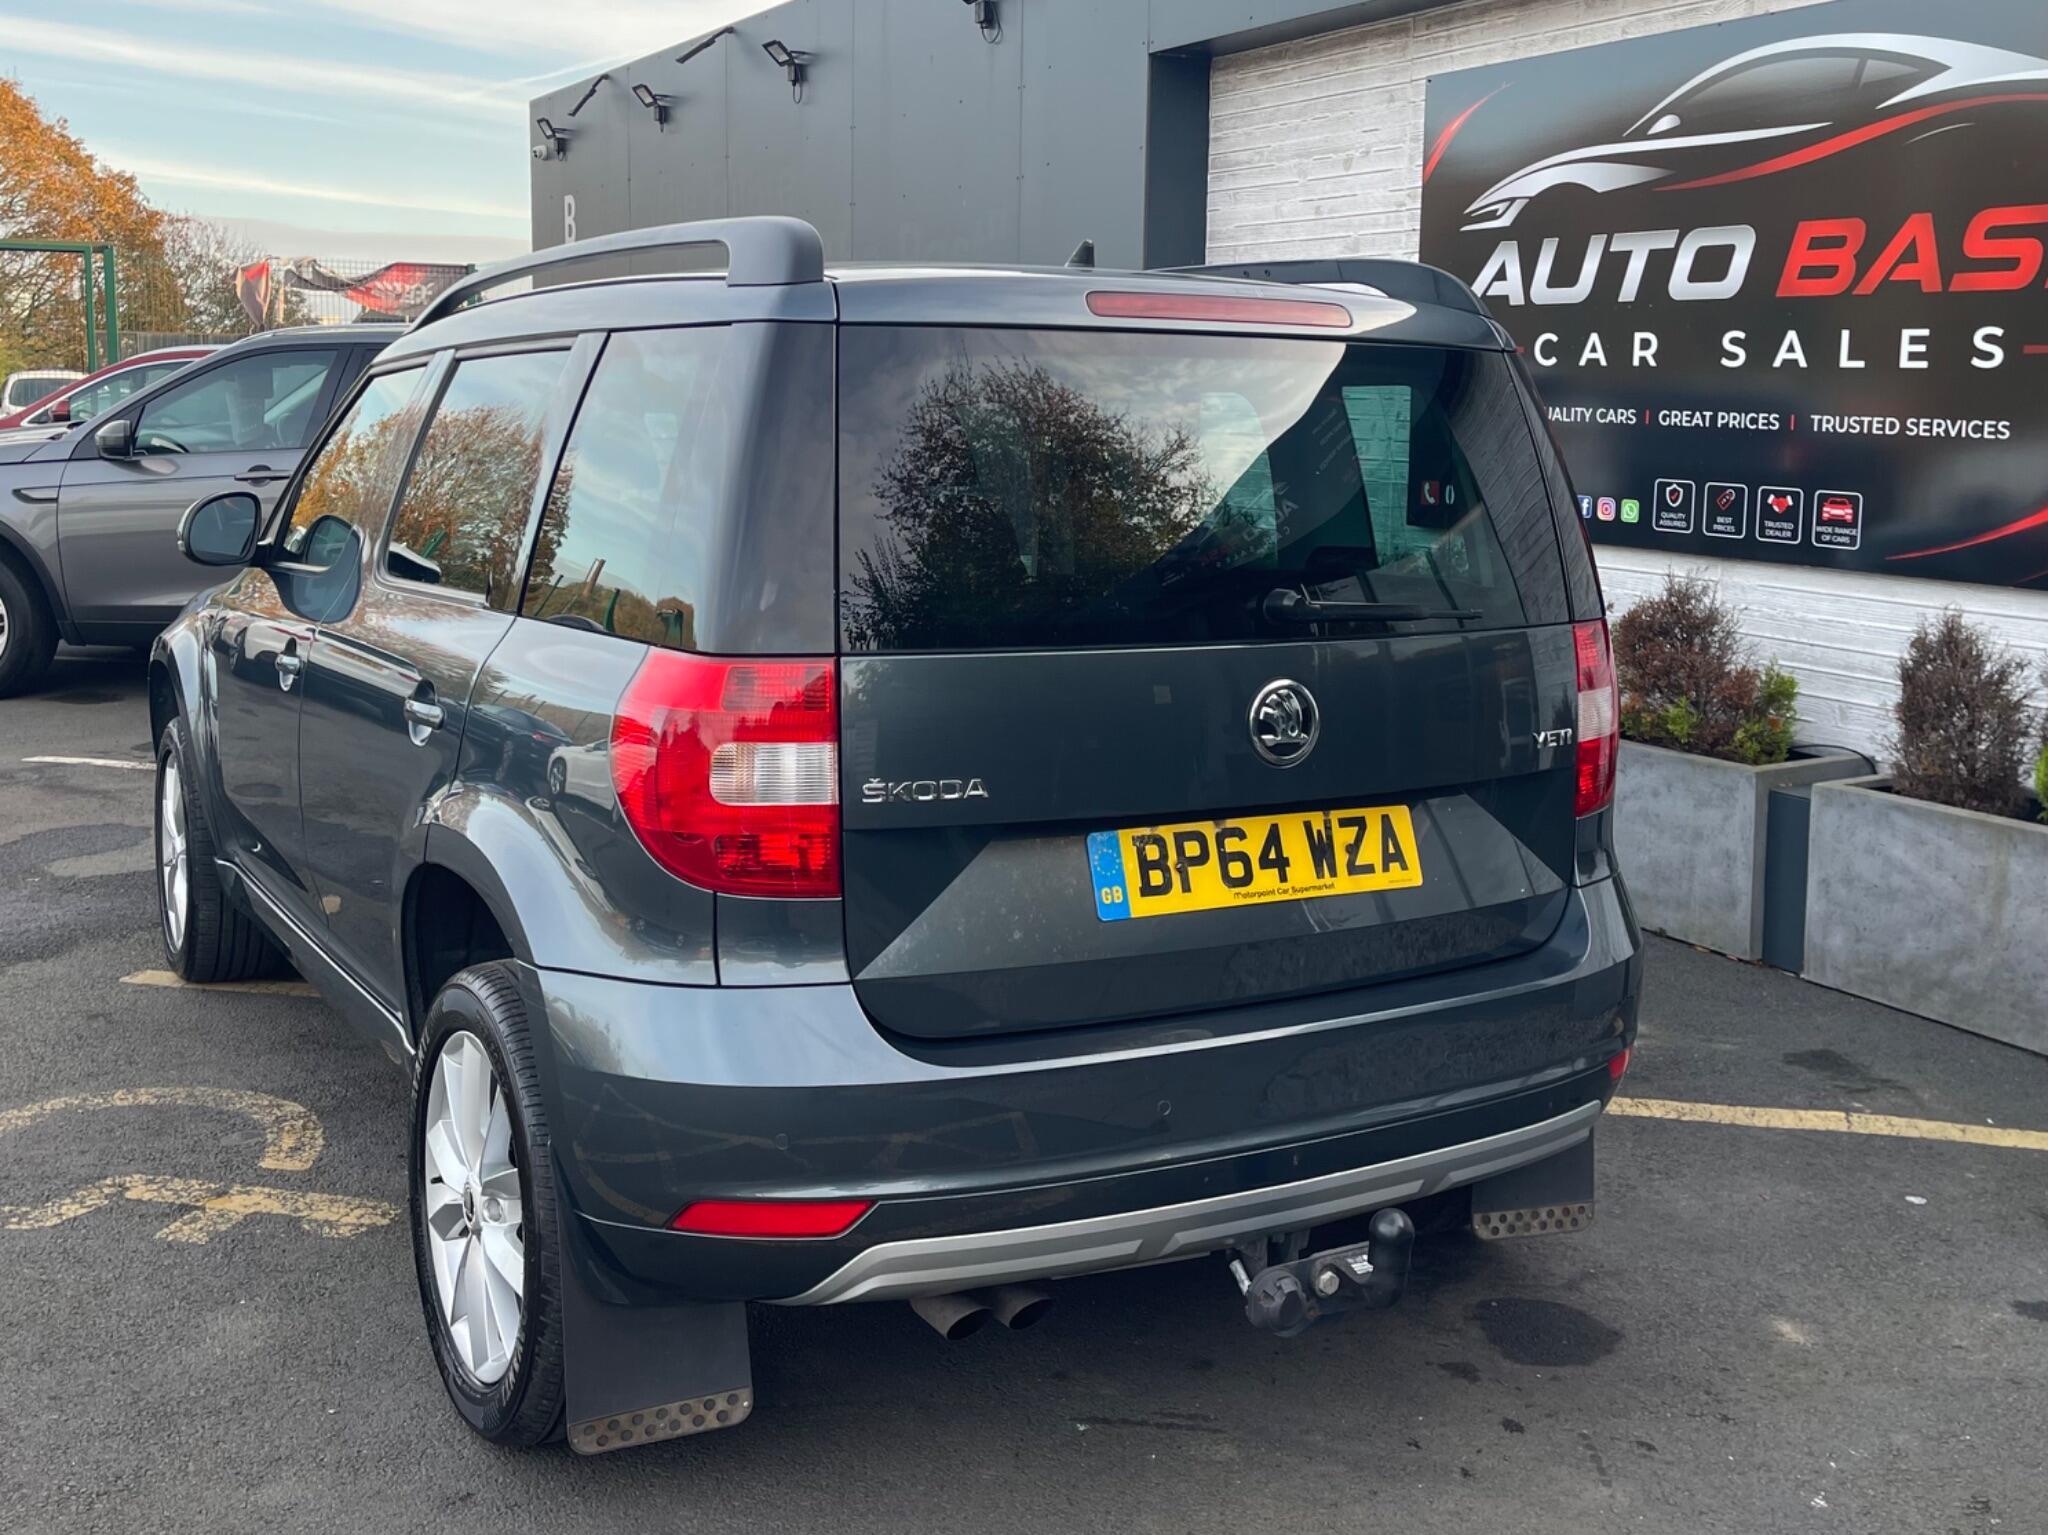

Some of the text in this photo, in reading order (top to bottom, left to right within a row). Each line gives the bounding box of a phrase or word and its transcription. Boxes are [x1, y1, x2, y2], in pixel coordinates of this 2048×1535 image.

[564, 194, 577, 244] B
[1470, 204, 2048, 306] AUTO BAS
[1534, 326, 2006, 370] CAR SALES
[1596, 408, 1637, 425] CARS
[1658, 410, 1780, 431] GREAT PRICES
[1810, 414, 2011, 440] TRUSTED SERVICES
[1659, 519, 1687, 528] ASSURED
[1660, 511, 1686, 520] QUALITY
[1716, 516, 1734, 524] BEST
[1763, 520, 1794, 530] TRUSTED
[1713, 524, 1736, 532] PRICES
[1765, 529, 1792, 538] DEALER
[1816, 525, 1857, 536] WIDE RANGE
[1821, 534, 1851, 544] OF CARS
[1532, 728, 1572, 749] YETI
[862, 777, 989, 803] ŠKODA
[1132, 813, 1410, 898] BP64 WZA
[1102, 886, 1124, 905] GB
[1233, 882, 1336, 901] Motorpoint Car Supermarket
